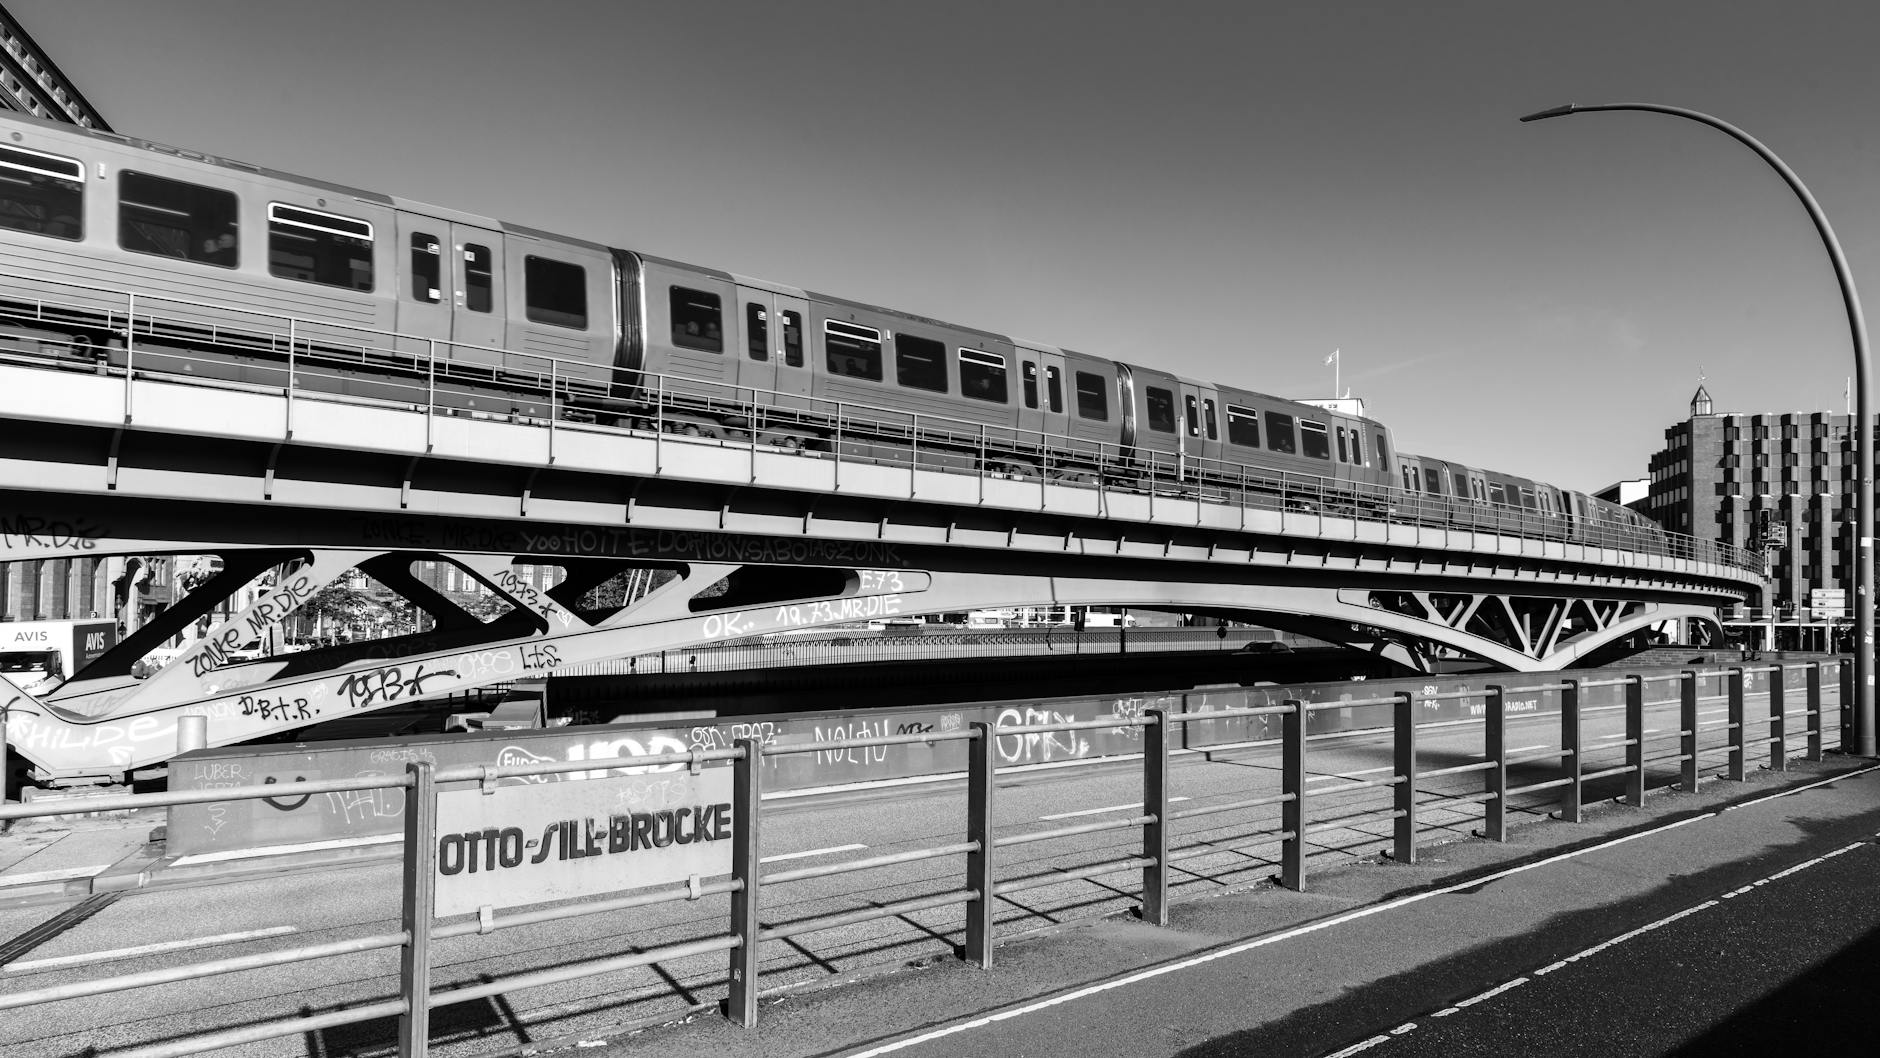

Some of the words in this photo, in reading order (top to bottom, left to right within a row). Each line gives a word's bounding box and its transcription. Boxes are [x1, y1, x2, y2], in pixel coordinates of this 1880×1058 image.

[493, 569, 538, 606] 1973
[14, 631, 48, 642] AVIS
[85, 631, 105, 651] AVIS
